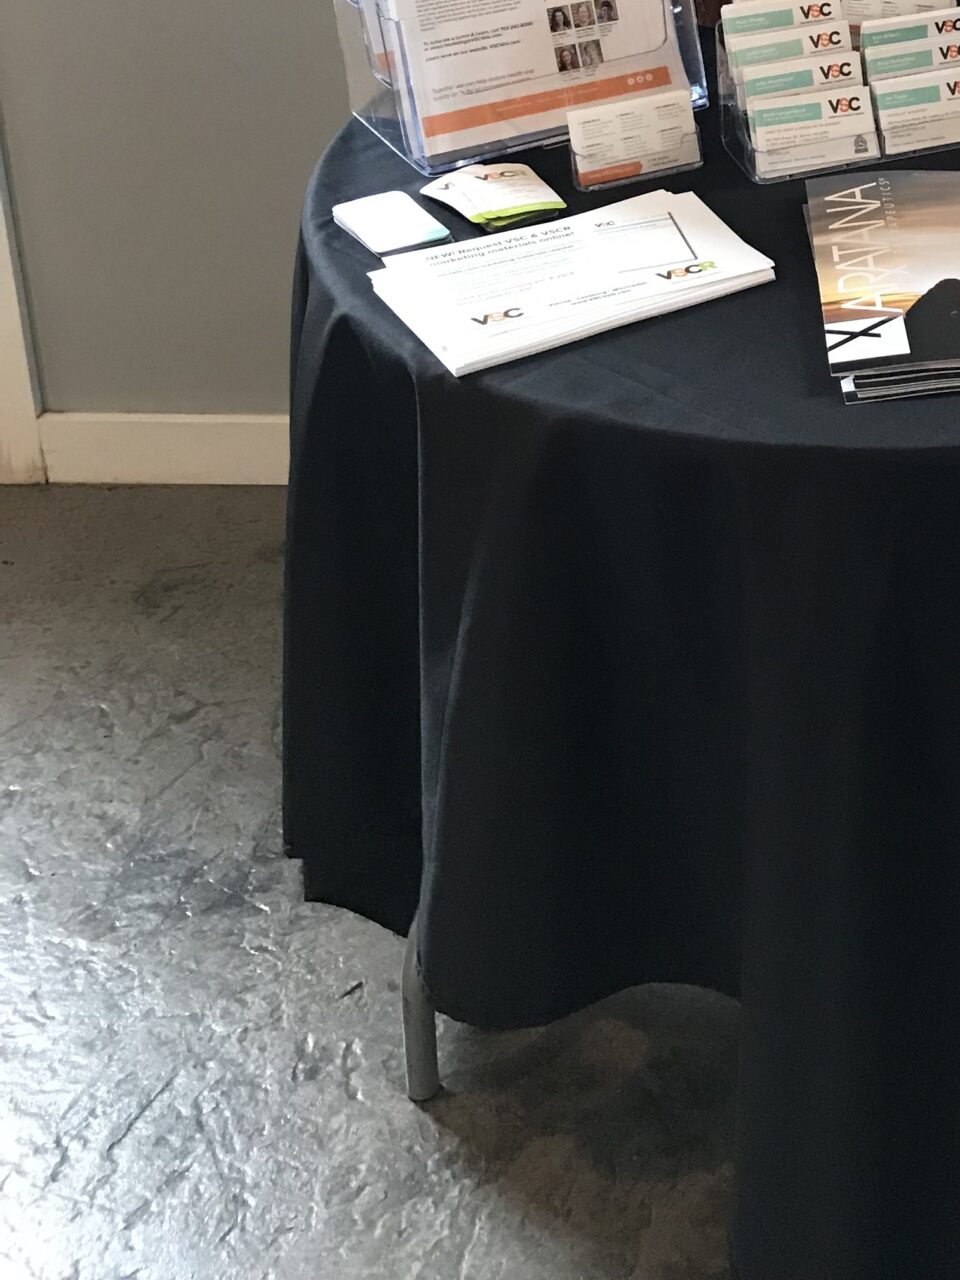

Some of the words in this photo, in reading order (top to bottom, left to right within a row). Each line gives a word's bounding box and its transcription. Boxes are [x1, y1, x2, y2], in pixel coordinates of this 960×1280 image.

[800, 3, 832, 19] VSC
[809, 31, 841, 48] VSC
[819, 62, 852, 79] VSC
[828, 97, 861, 114] VSC
[655, 260, 719, 280] VSCR
[470, 307, 524, 326] VSC
